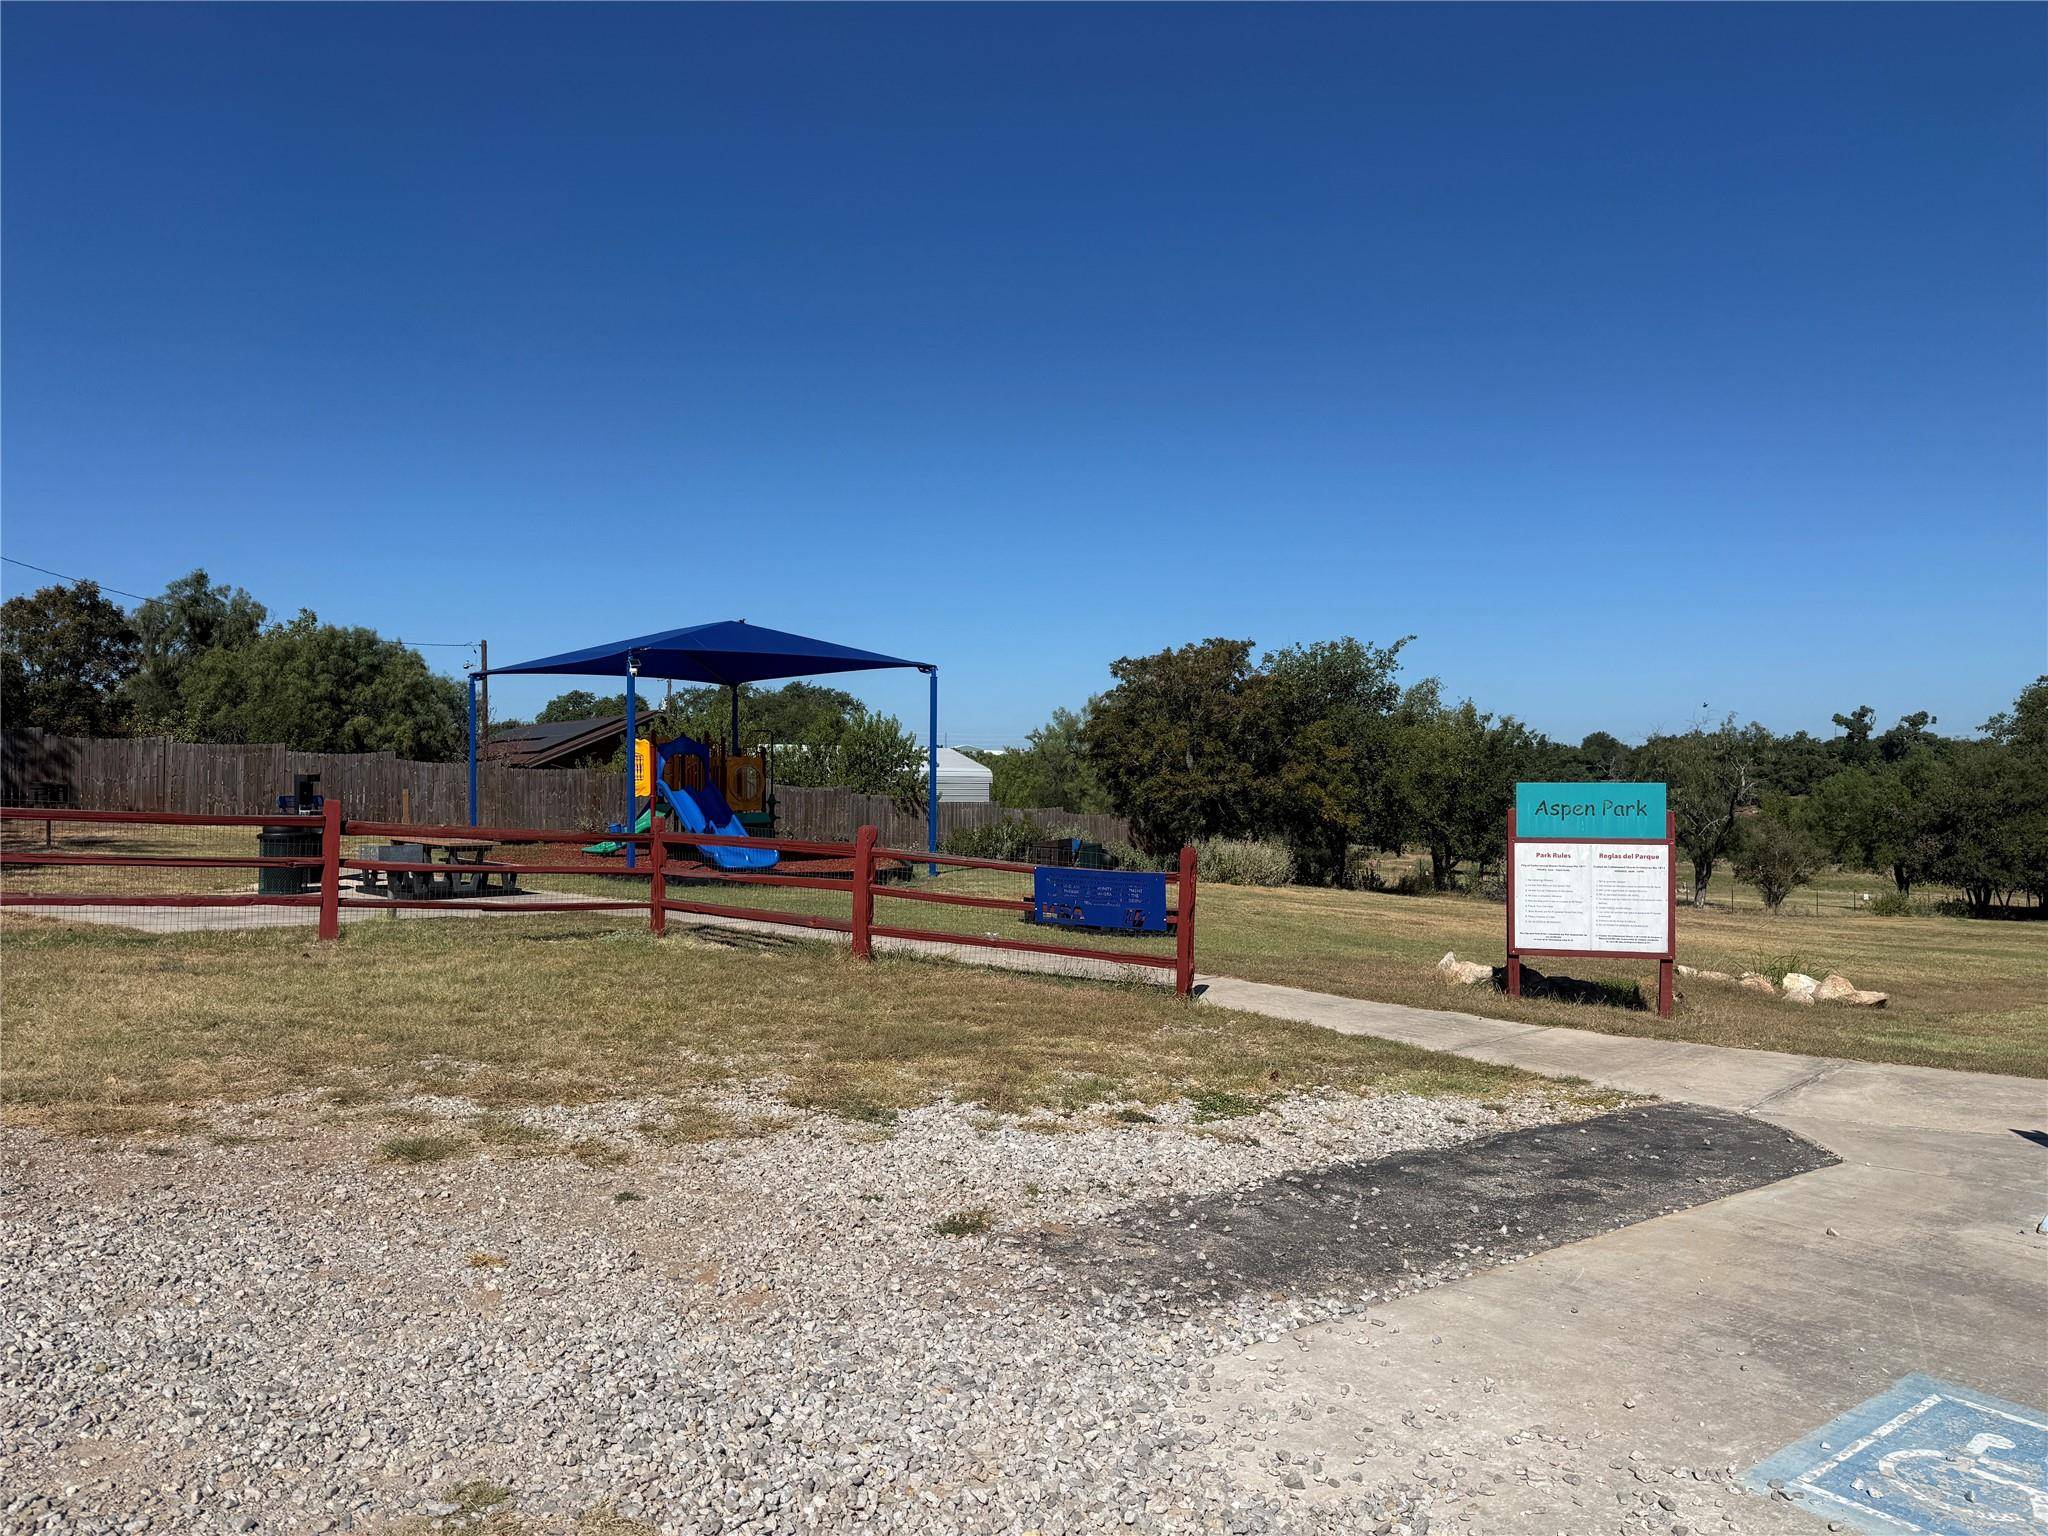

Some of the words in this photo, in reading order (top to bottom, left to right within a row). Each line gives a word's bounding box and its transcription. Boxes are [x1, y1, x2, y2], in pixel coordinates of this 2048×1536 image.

[1535, 799, 1596, 821] Aspen
[1602, 799, 1648, 817] Park
[1599, 852, 1622, 860] Reglas
[1623, 852, 1634, 860] del
[1635, 853, 1660, 861] Parque
